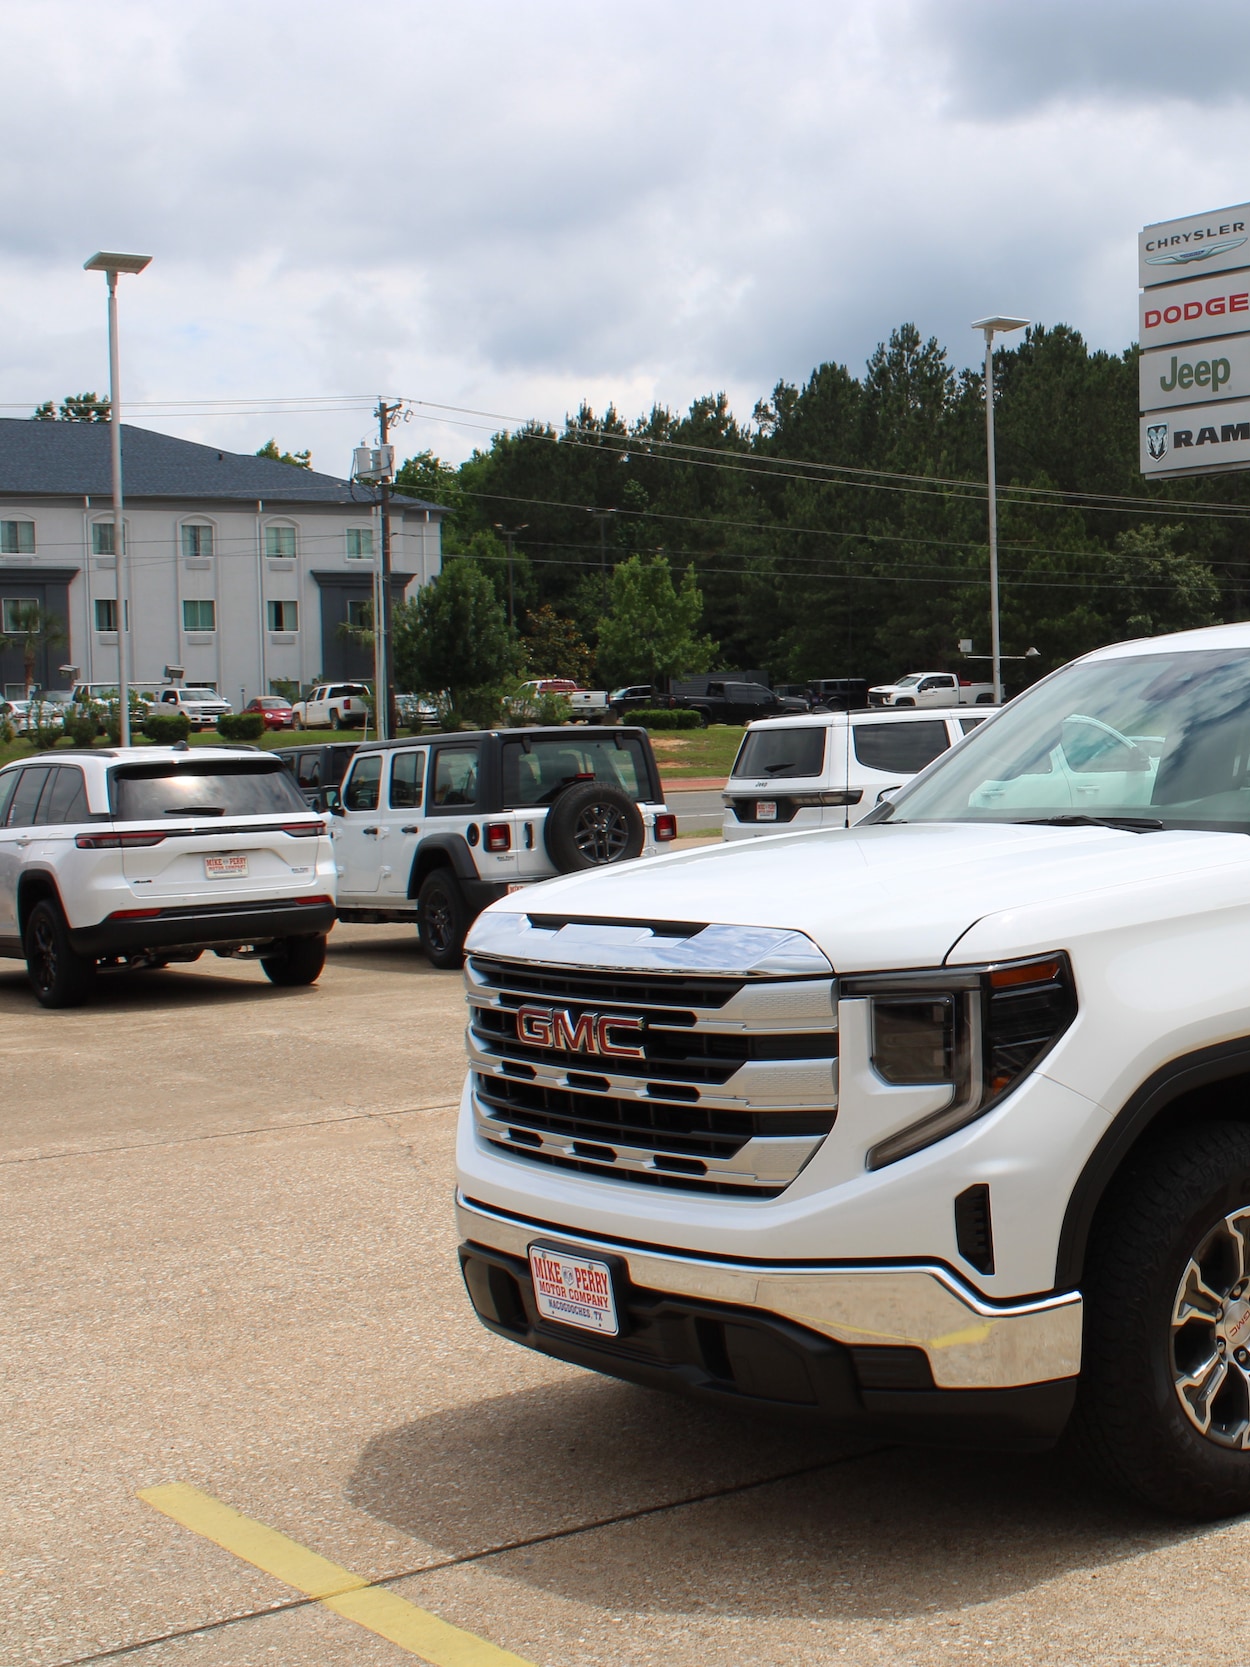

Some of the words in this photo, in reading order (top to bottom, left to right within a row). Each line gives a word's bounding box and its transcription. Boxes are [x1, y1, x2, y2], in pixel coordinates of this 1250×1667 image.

[1145, 222, 1245, 251] CHRYSLER
[1144, 293, 1249, 329] DODGE
[1160, 355, 1231, 392] Jeep
[1173, 422, 1250, 449] RAM
[206, 858, 223, 867] MIKE
[229, 857, 246, 866] PERRY
[517, 1004, 646, 1059] GMC
[533, 1256, 563, 1285] MIKE
[574, 1267, 609, 1296] PERRY
[539, 1280, 567, 1298] MOTOR
[568, 1288, 609, 1309] COMPANY
[593, 1310, 603, 1321] TX
[1229, 1310, 1250, 1337] GMC
